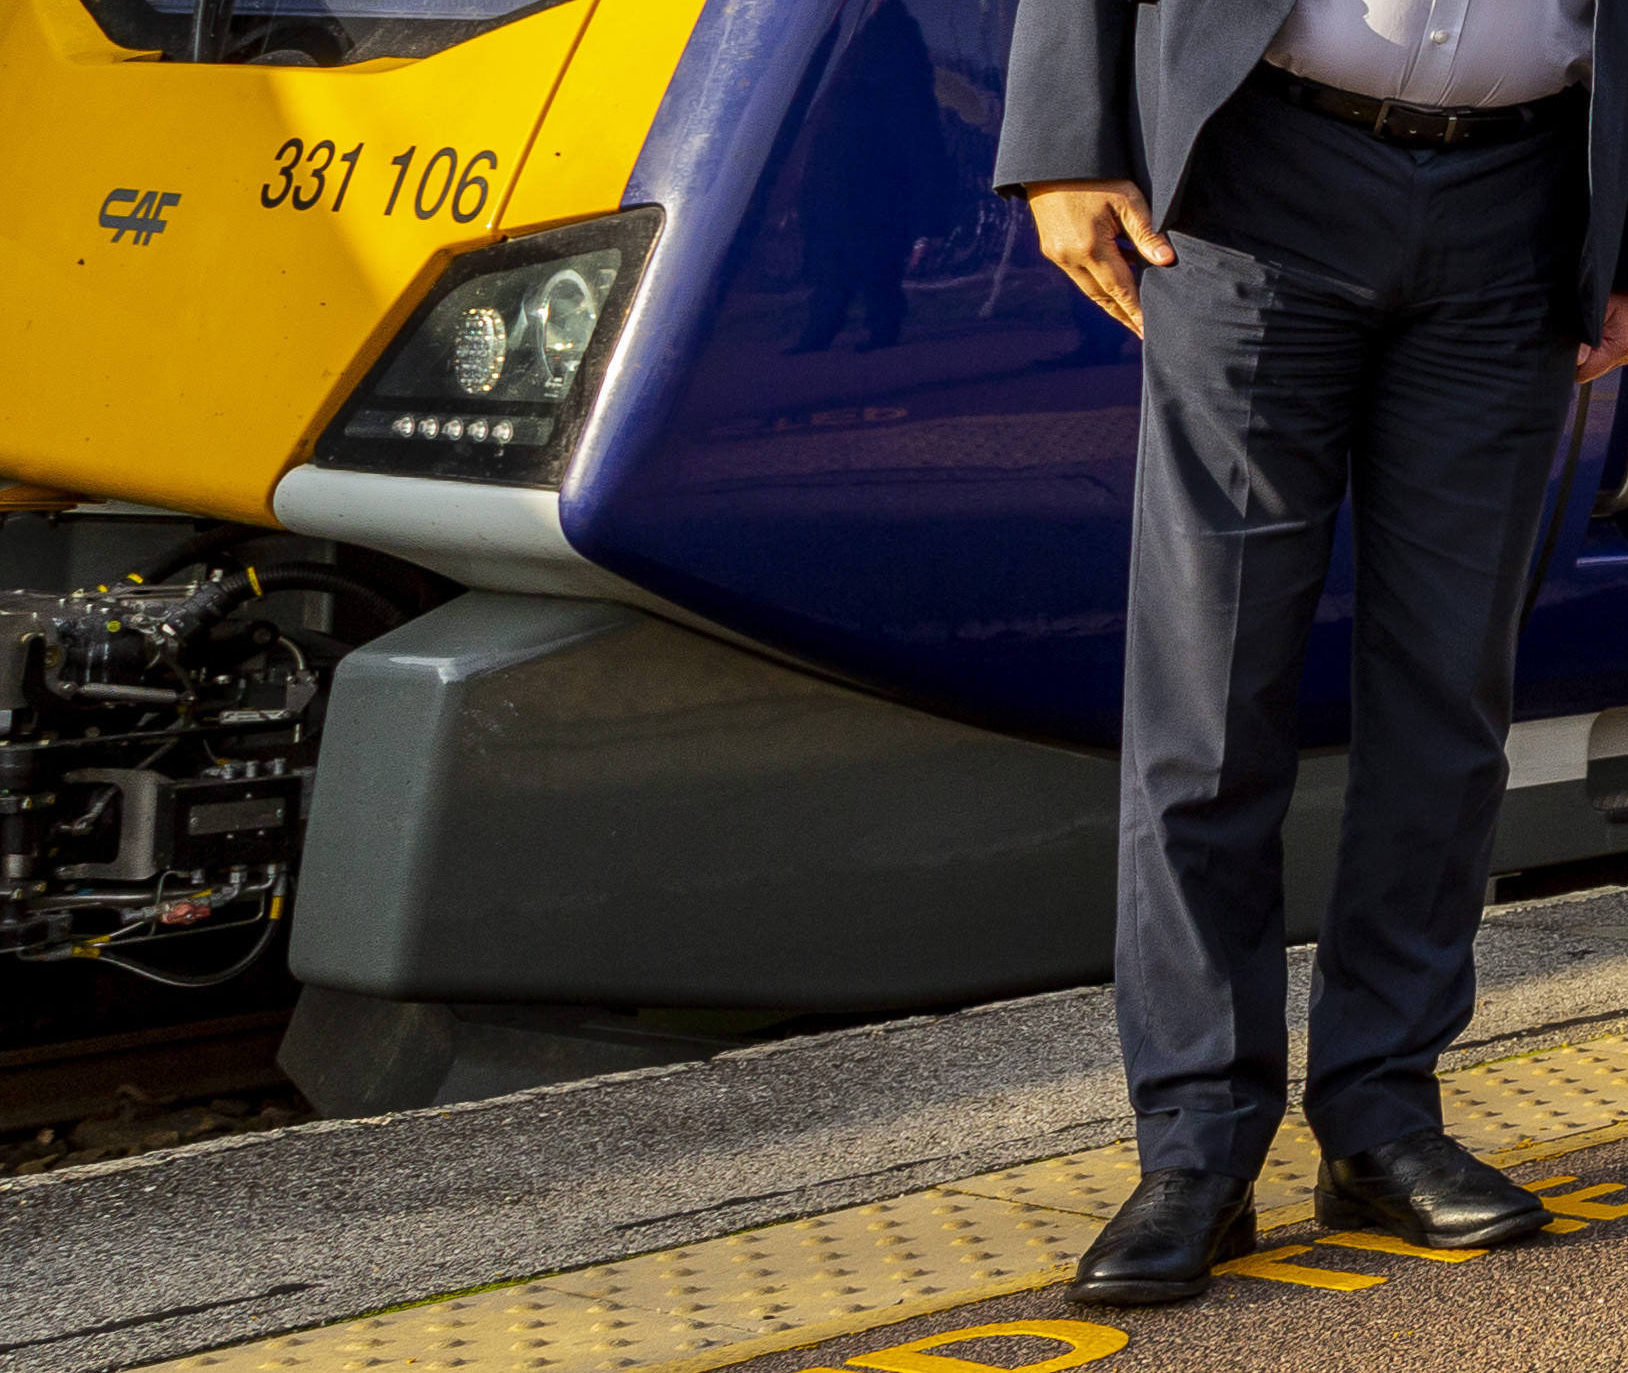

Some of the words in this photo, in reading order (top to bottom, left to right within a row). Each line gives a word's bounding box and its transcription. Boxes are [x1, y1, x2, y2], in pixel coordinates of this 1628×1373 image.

[99, 187, 182, 246] CAF
[261, 138, 364, 211] 331
[384, 145, 498, 223] 106
